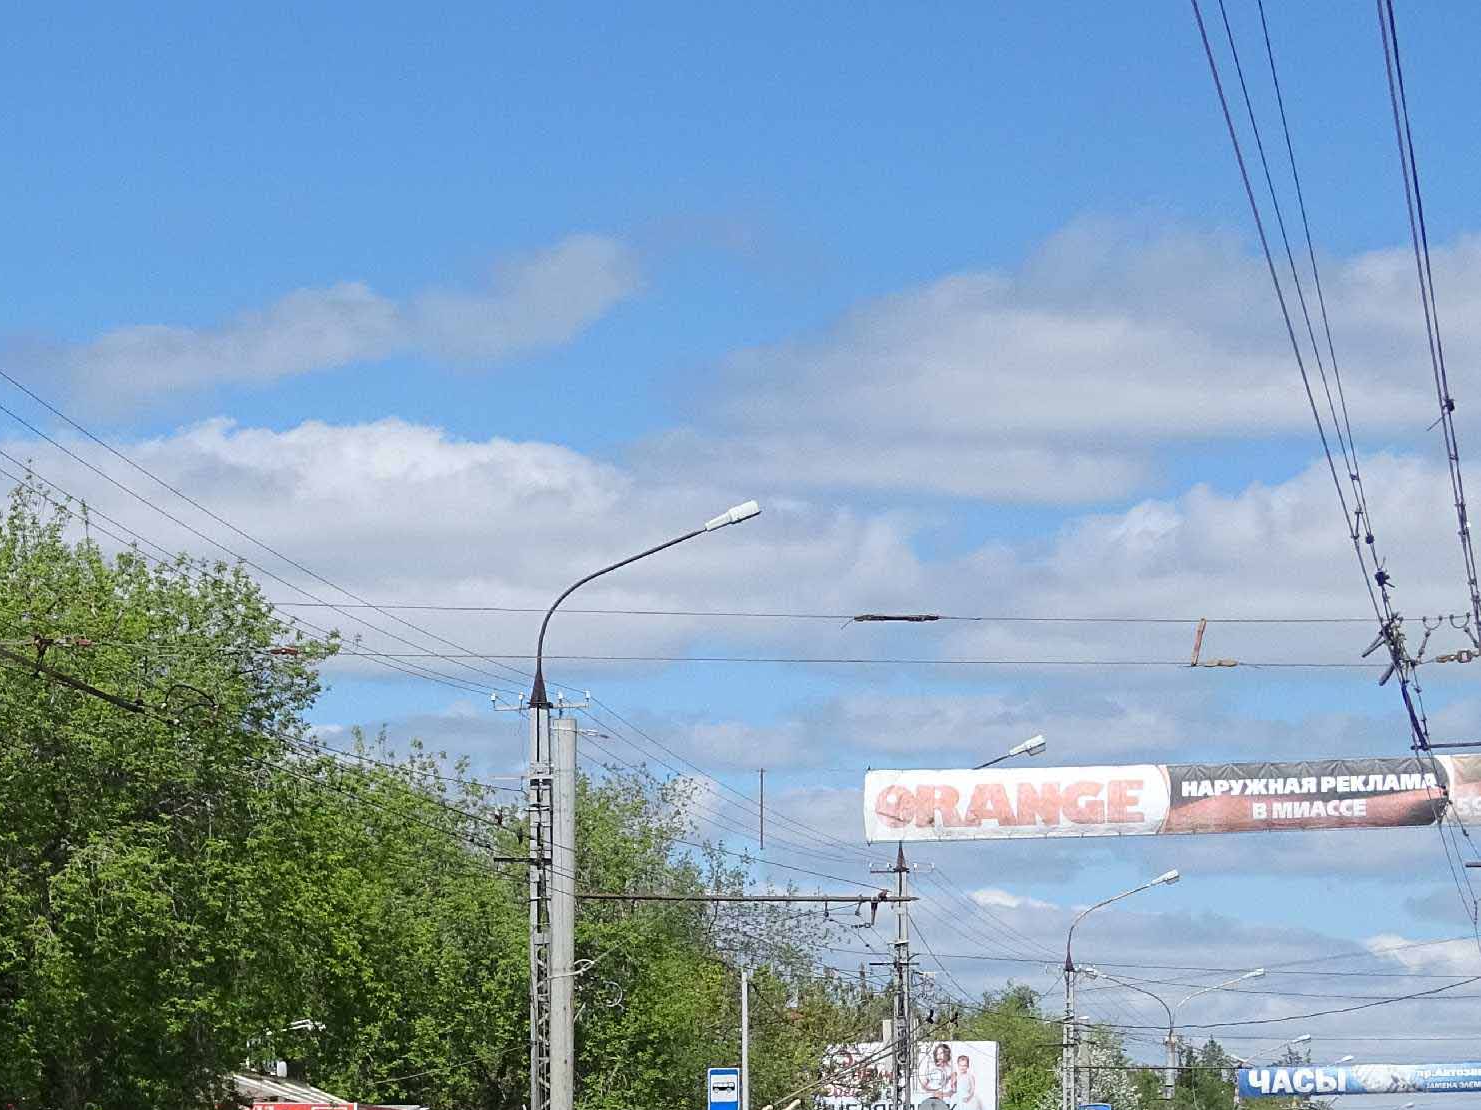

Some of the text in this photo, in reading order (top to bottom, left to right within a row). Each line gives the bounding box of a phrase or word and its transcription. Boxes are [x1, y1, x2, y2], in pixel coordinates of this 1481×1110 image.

[1181, 773, 1440, 797] НАРУЖНАЯ РЕКЛАМА
[875, 778, 1145, 828] ORANGE
[1252, 799, 1368, 819] В МИАССЕ
[1248, 1068, 1346, 1093] ЧАСЫ
